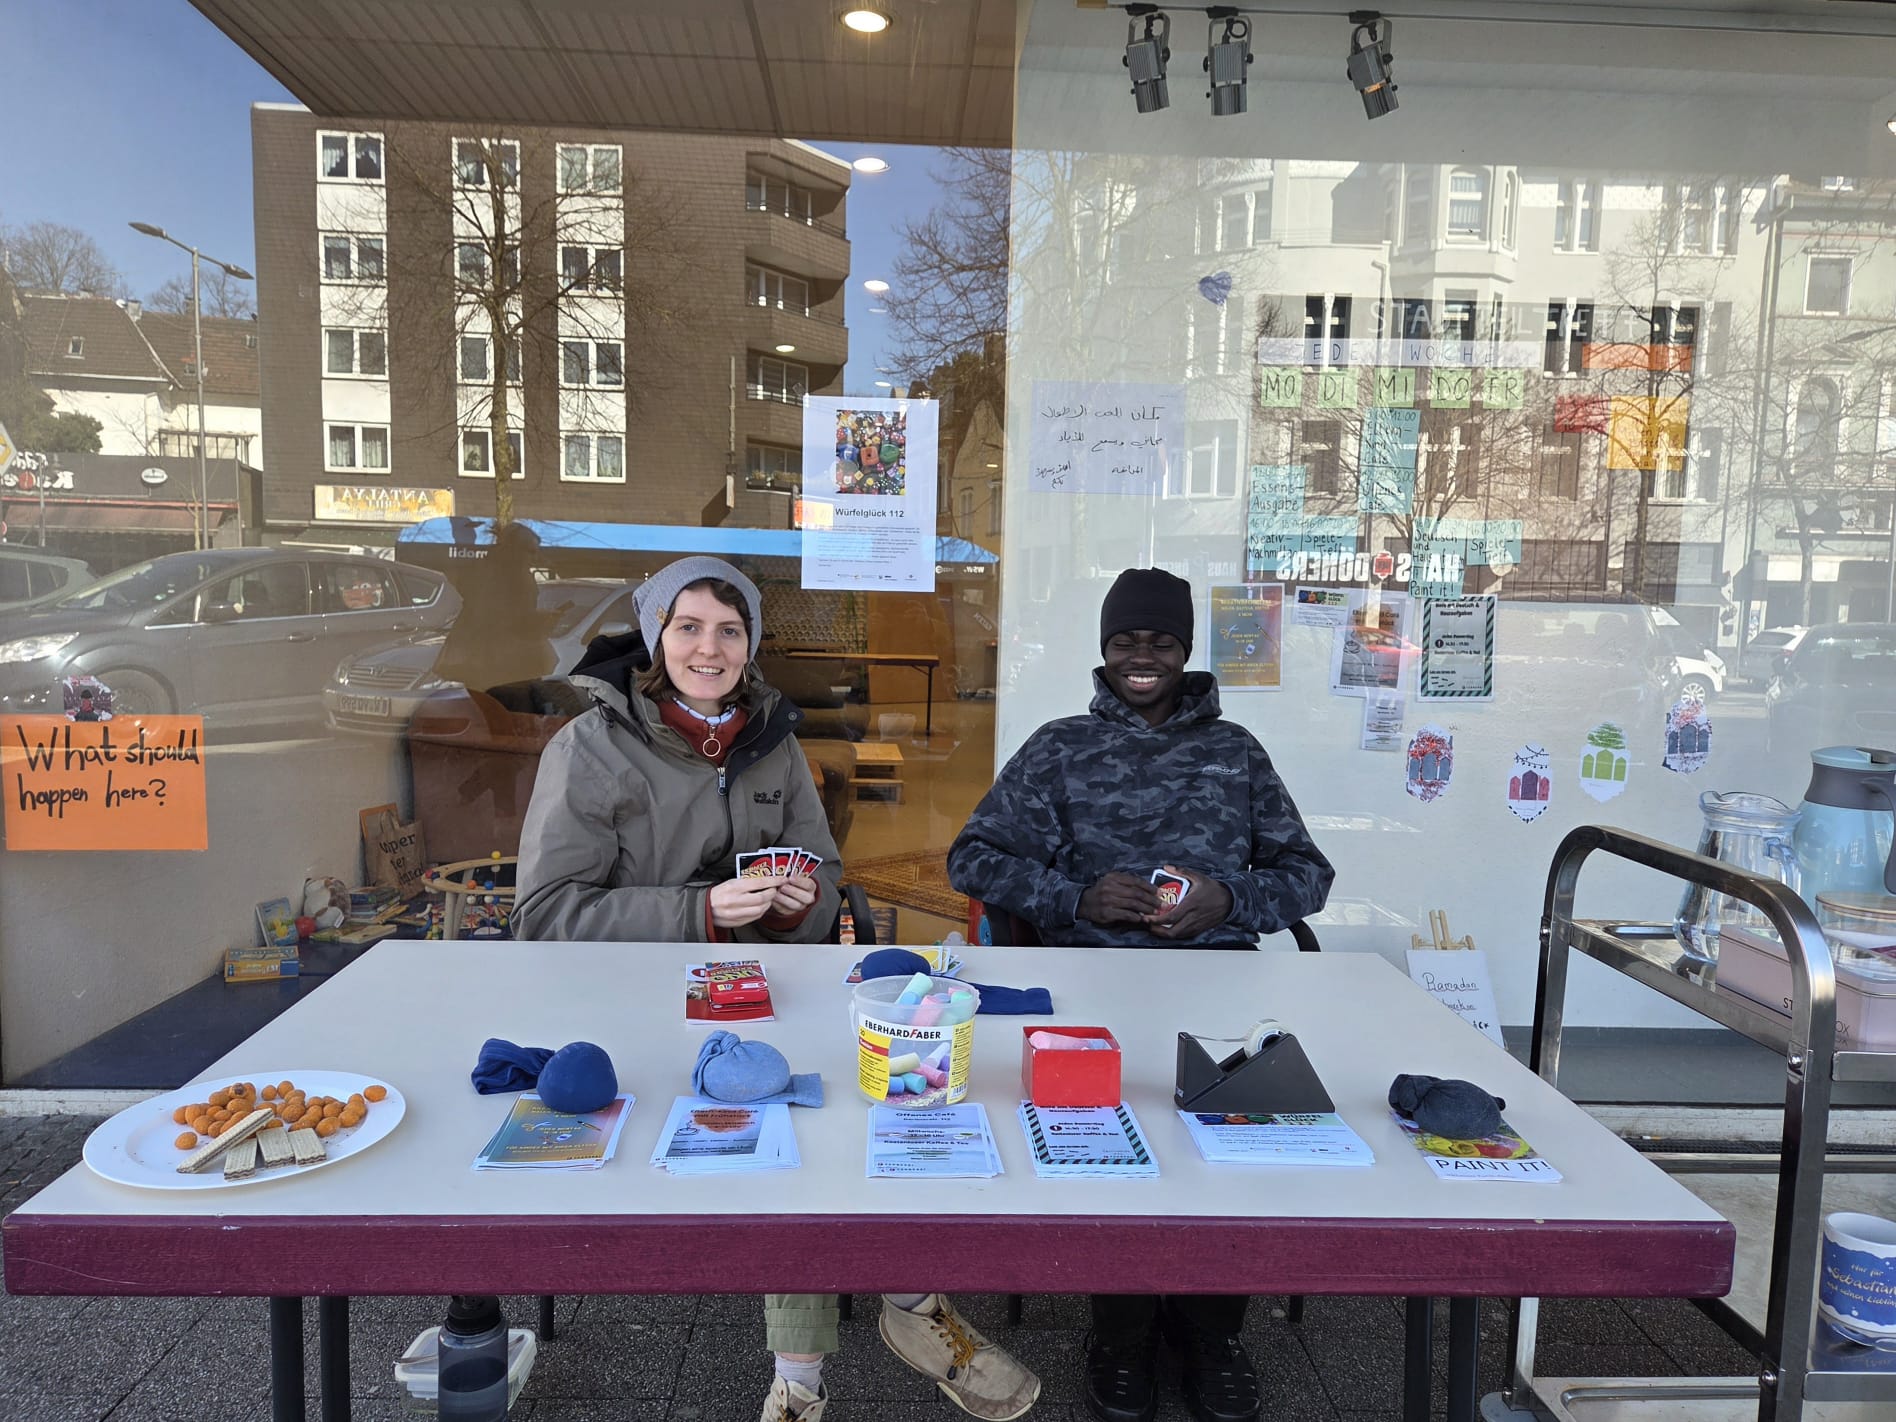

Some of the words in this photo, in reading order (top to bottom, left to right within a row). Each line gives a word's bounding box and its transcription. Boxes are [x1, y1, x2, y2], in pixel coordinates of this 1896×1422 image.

[1265, 374, 1296, 400] MO
[1324, 376, 1344, 401] DI
[1379, 374, 1408, 400] MI
[1437, 376, 1470, 400] DO
[835, 508, 887, 518] Würfelglück
[889, 509, 905, 518] 112
[1410, 580, 1433, 597] Paint
[16, 725, 117, 772] What
[125, 728, 200, 766] should
[18, 772, 89, 819] happen
[105, 771, 168, 810] here?
[1421, 971, 1479, 992] Ramadan
[1435, 1159, 1511, 1171] PAINT
[1518, 1160, 1551, 1172] IT!
